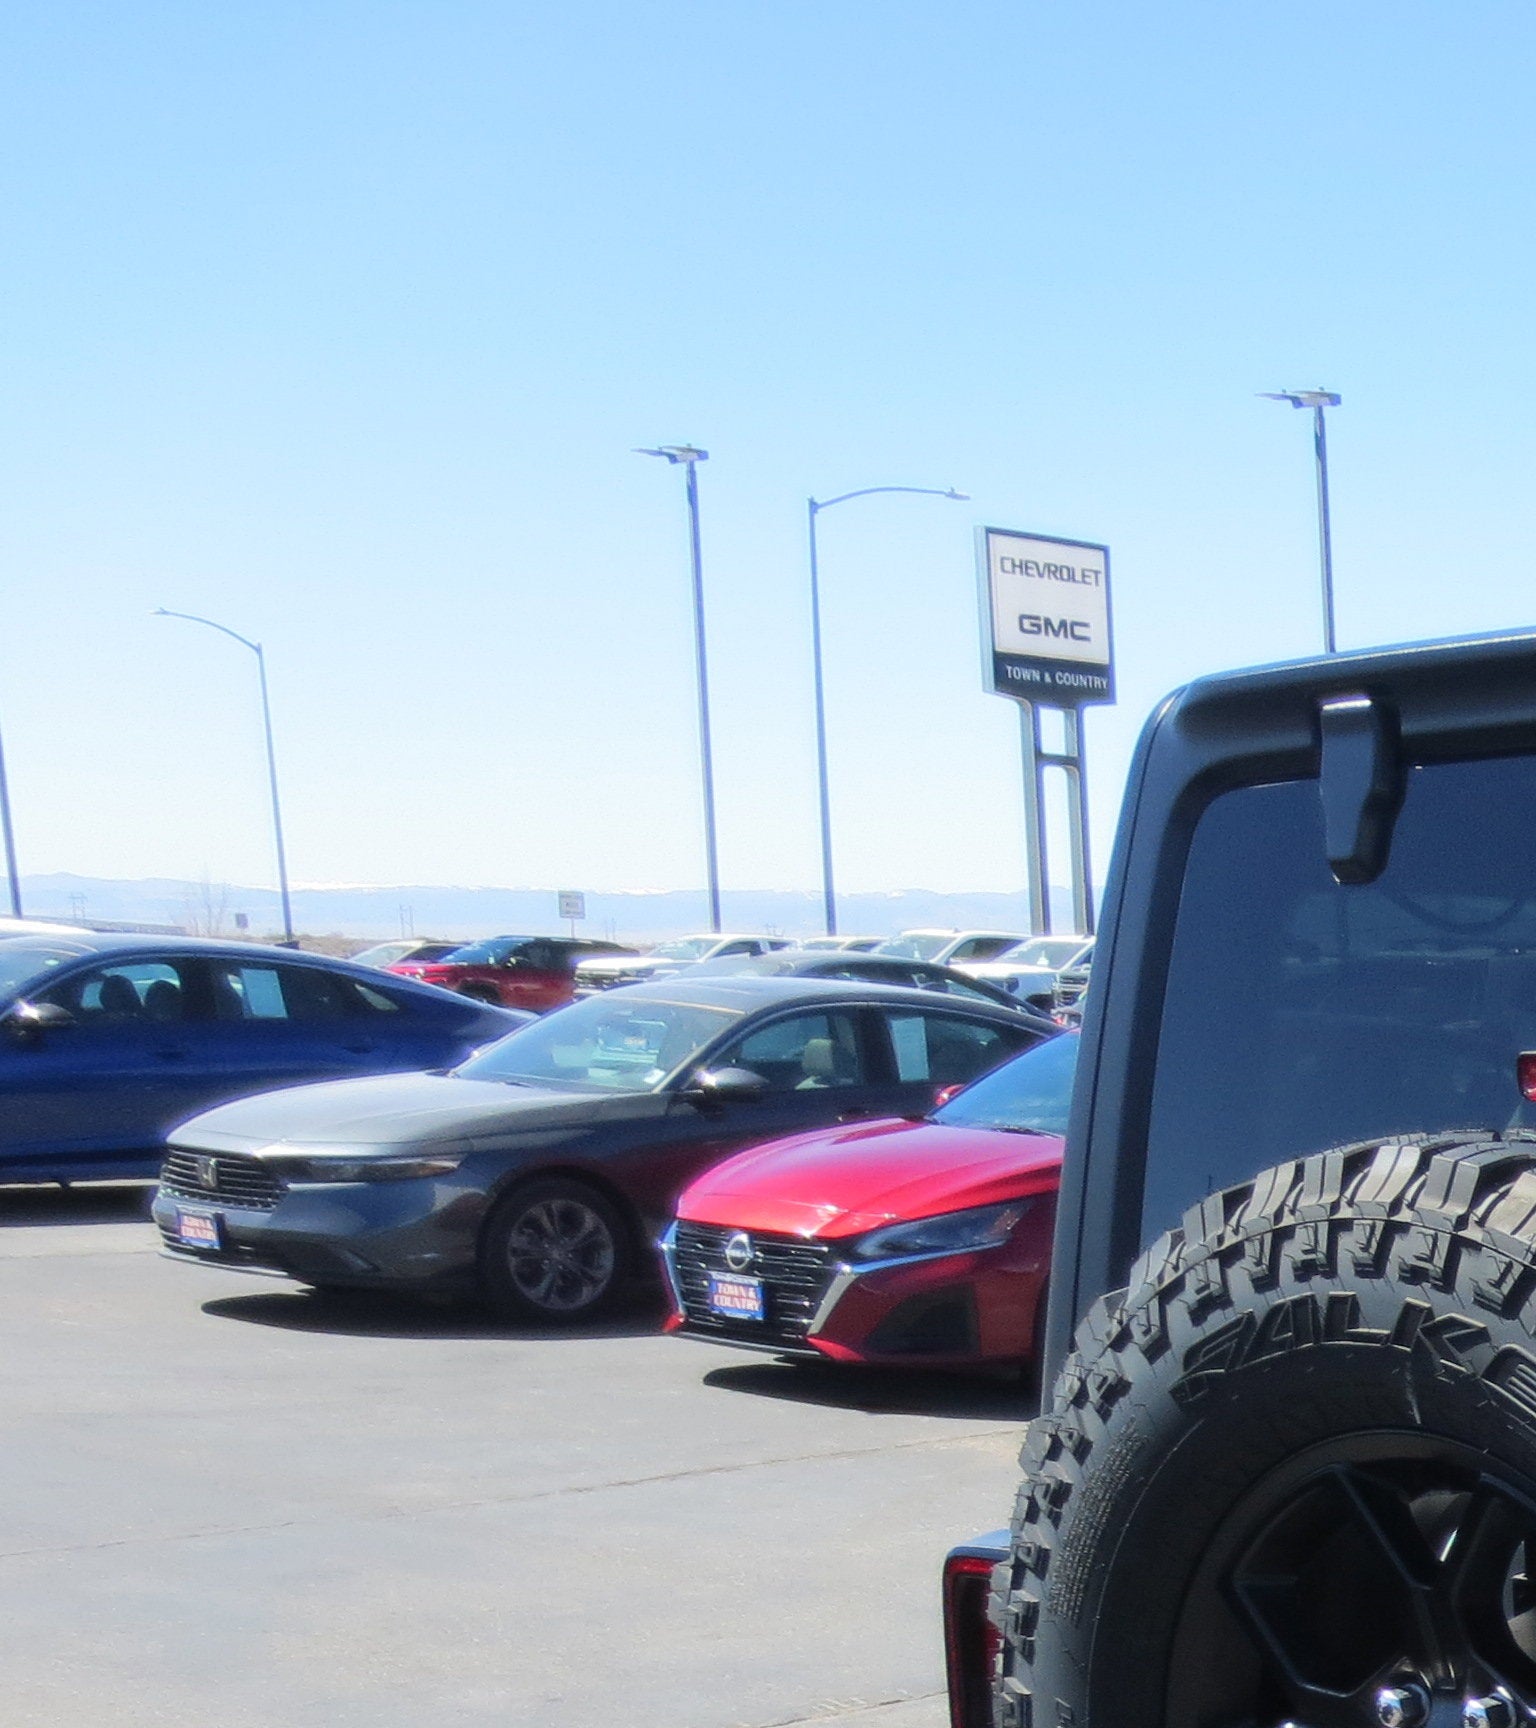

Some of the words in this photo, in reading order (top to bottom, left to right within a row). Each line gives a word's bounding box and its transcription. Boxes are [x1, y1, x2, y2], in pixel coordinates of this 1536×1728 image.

[1000, 556, 1102, 587] CHEVROLET
[1018, 613, 1091, 642] GMC
[1006, 665, 1041, 683] TOWN
[1044, 673, 1051, 684] &
[1055, 671, 1109, 690] COUNTRY
[713, 1294, 760, 1312] COUNTRY
